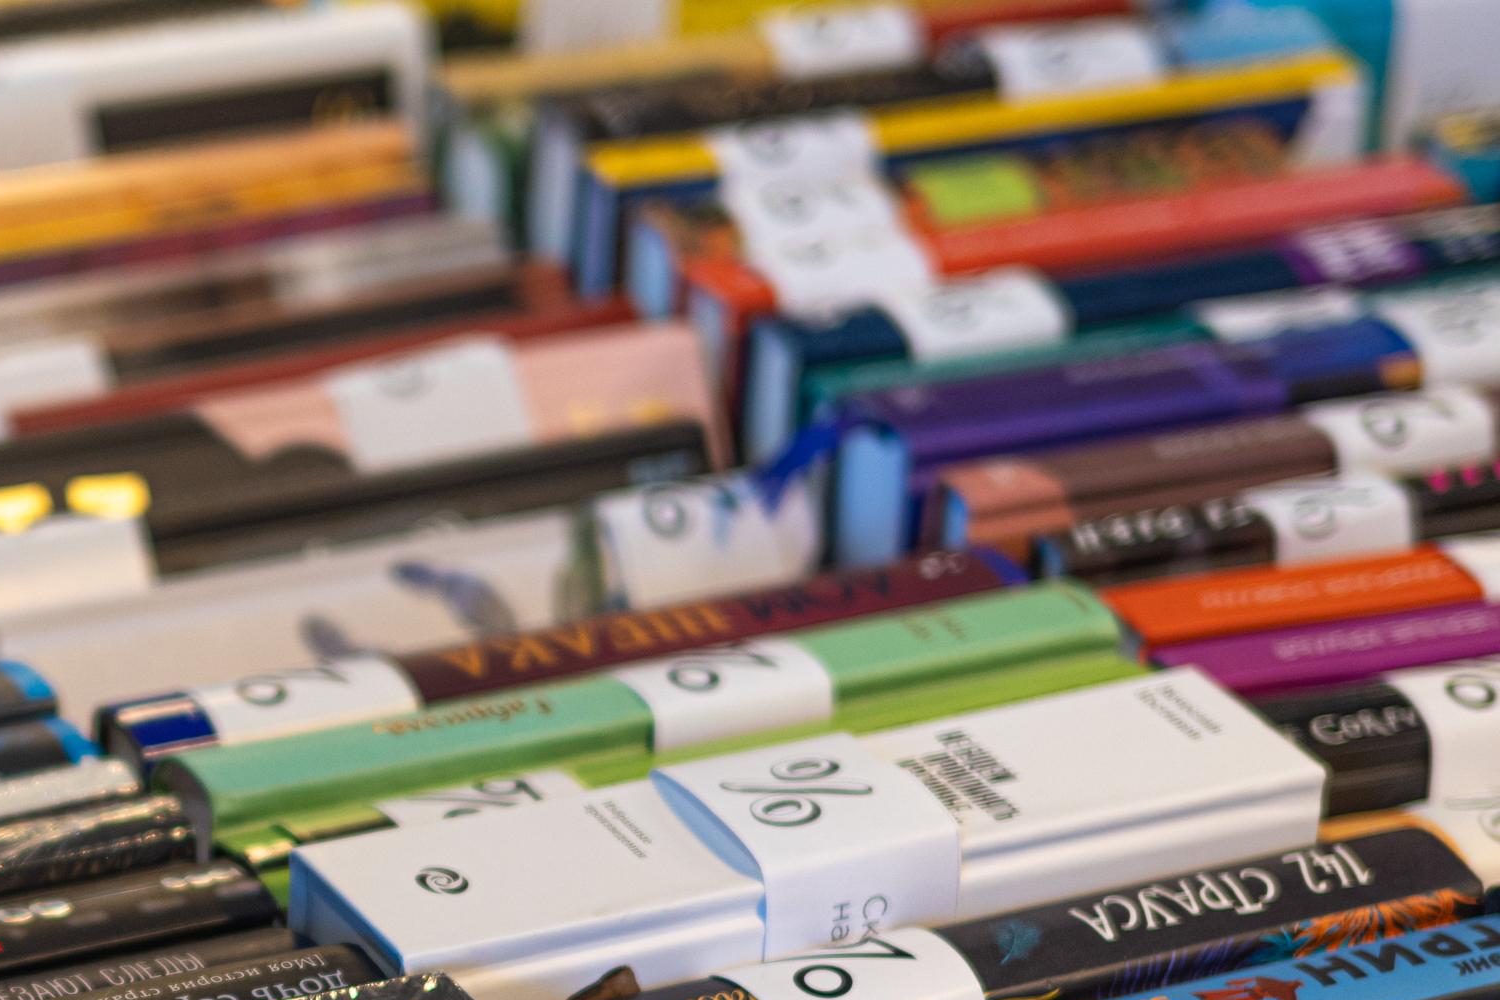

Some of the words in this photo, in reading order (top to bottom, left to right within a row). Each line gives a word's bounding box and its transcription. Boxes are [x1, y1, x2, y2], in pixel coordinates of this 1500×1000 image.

[1281, 844, 1375, 893] 142
[1069, 866, 1282, 942] СТРАУСА
[99, 951, 206, 986] СЛЕДЫ
[169, 967, 261, 993] история
